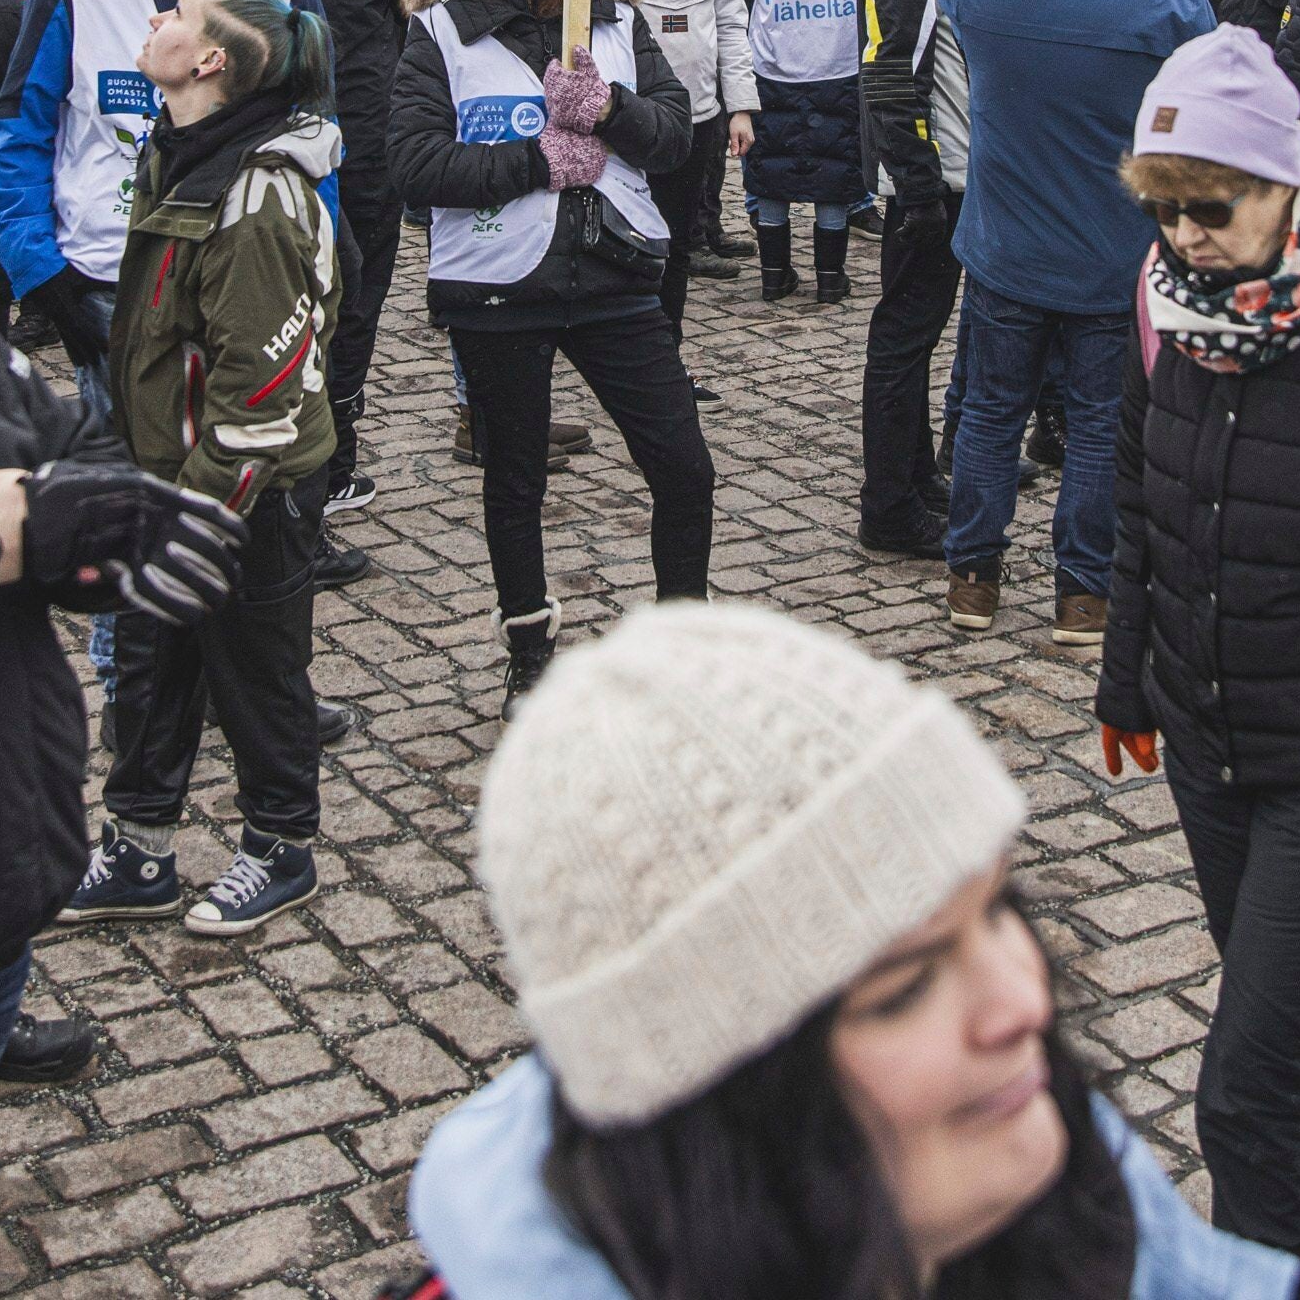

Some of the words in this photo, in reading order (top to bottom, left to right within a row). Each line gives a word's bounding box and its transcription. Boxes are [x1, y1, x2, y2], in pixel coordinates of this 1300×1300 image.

[107, 78, 147, 88] RUOKAA
[107, 88, 148, 98] OMASTA
[107, 98, 148, 108] MAASTA
[464, 105, 505, 117] RUOKAA
[465, 114, 505, 125] OMASTA
[467, 124, 506, 134] MAASTA
[471, 223, 503, 233] PEFC
[262, 292, 312, 362] HALTI
